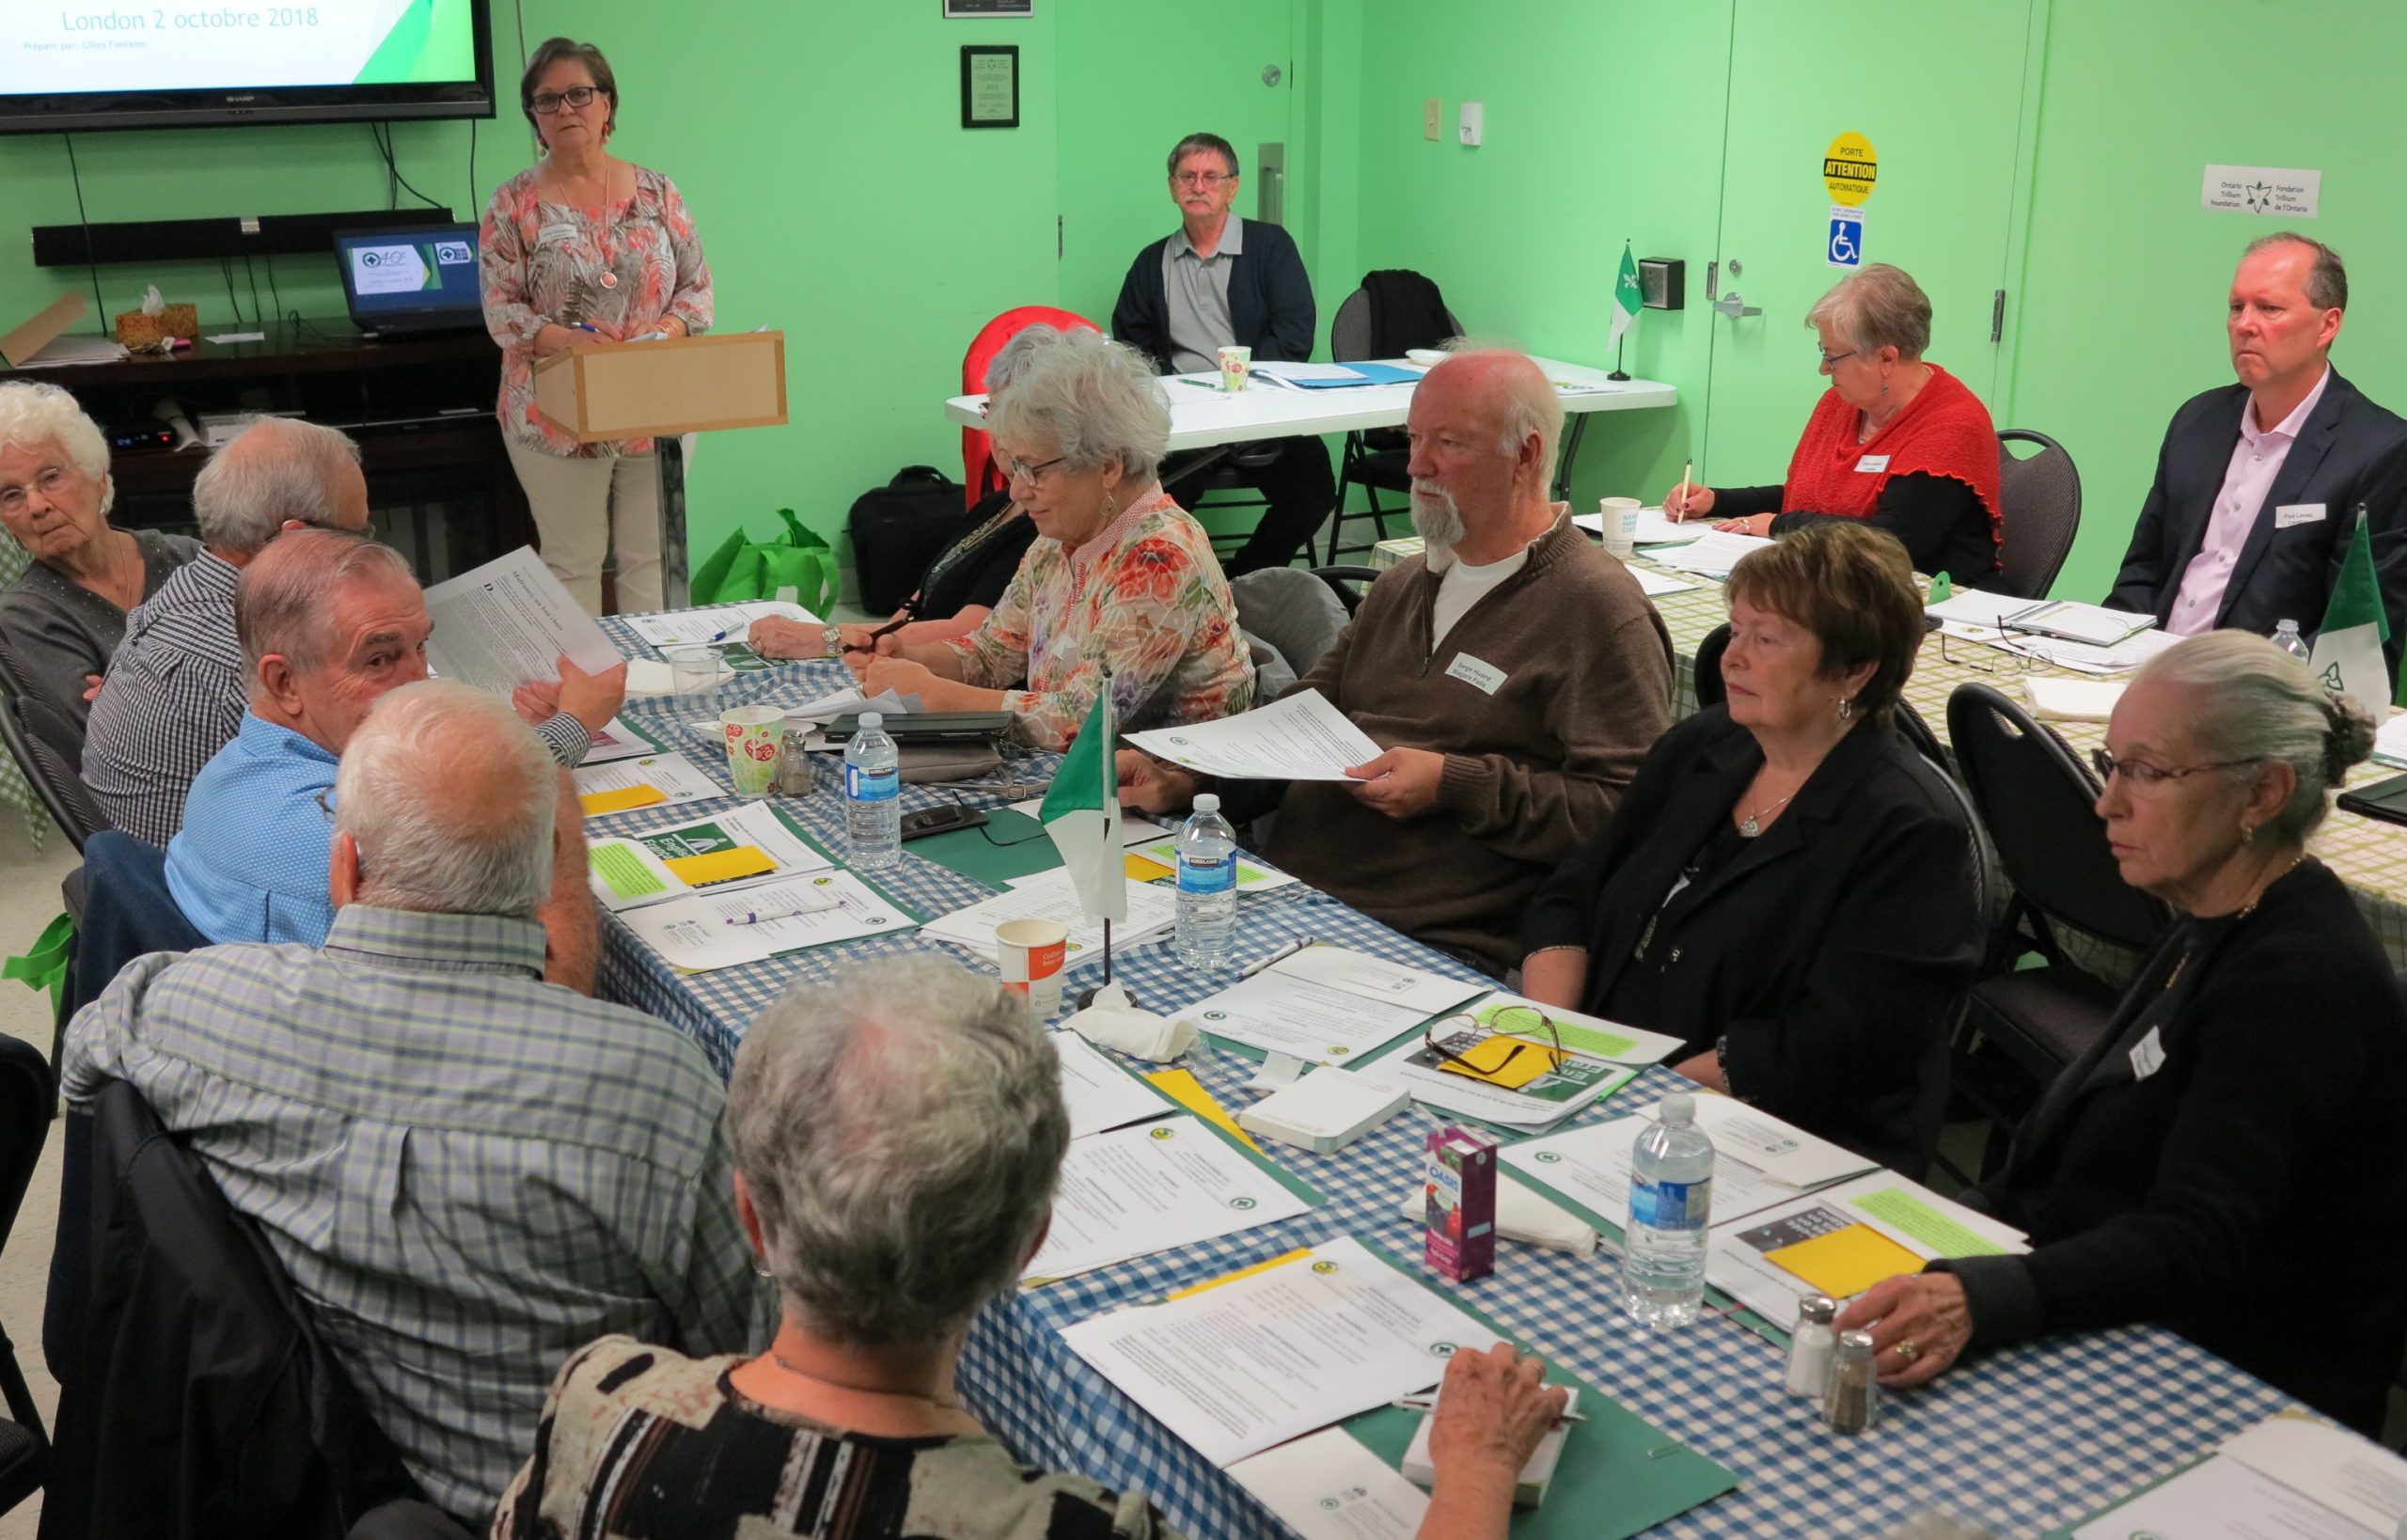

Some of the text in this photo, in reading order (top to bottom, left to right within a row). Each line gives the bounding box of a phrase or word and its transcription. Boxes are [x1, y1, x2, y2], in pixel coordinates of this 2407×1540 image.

[61, 6, 320, 32] London 2 octobre 2018
[1840, 147, 1864, 158] PORTE
[1824, 160, 1876, 180] ATTENTION
[1828, 181, 1870, 195] AUTOMATIQUE
[2221, 181, 2242, 190] Ontario
[2275, 184, 2305, 194] Fondation
[2210, 198, 2241, 208] Foundation
[2275, 194, 2296, 202] Trillium
[2282, 204, 2309, 212] l'Ontario
[1429, 1166, 1459, 1194] OASIS
